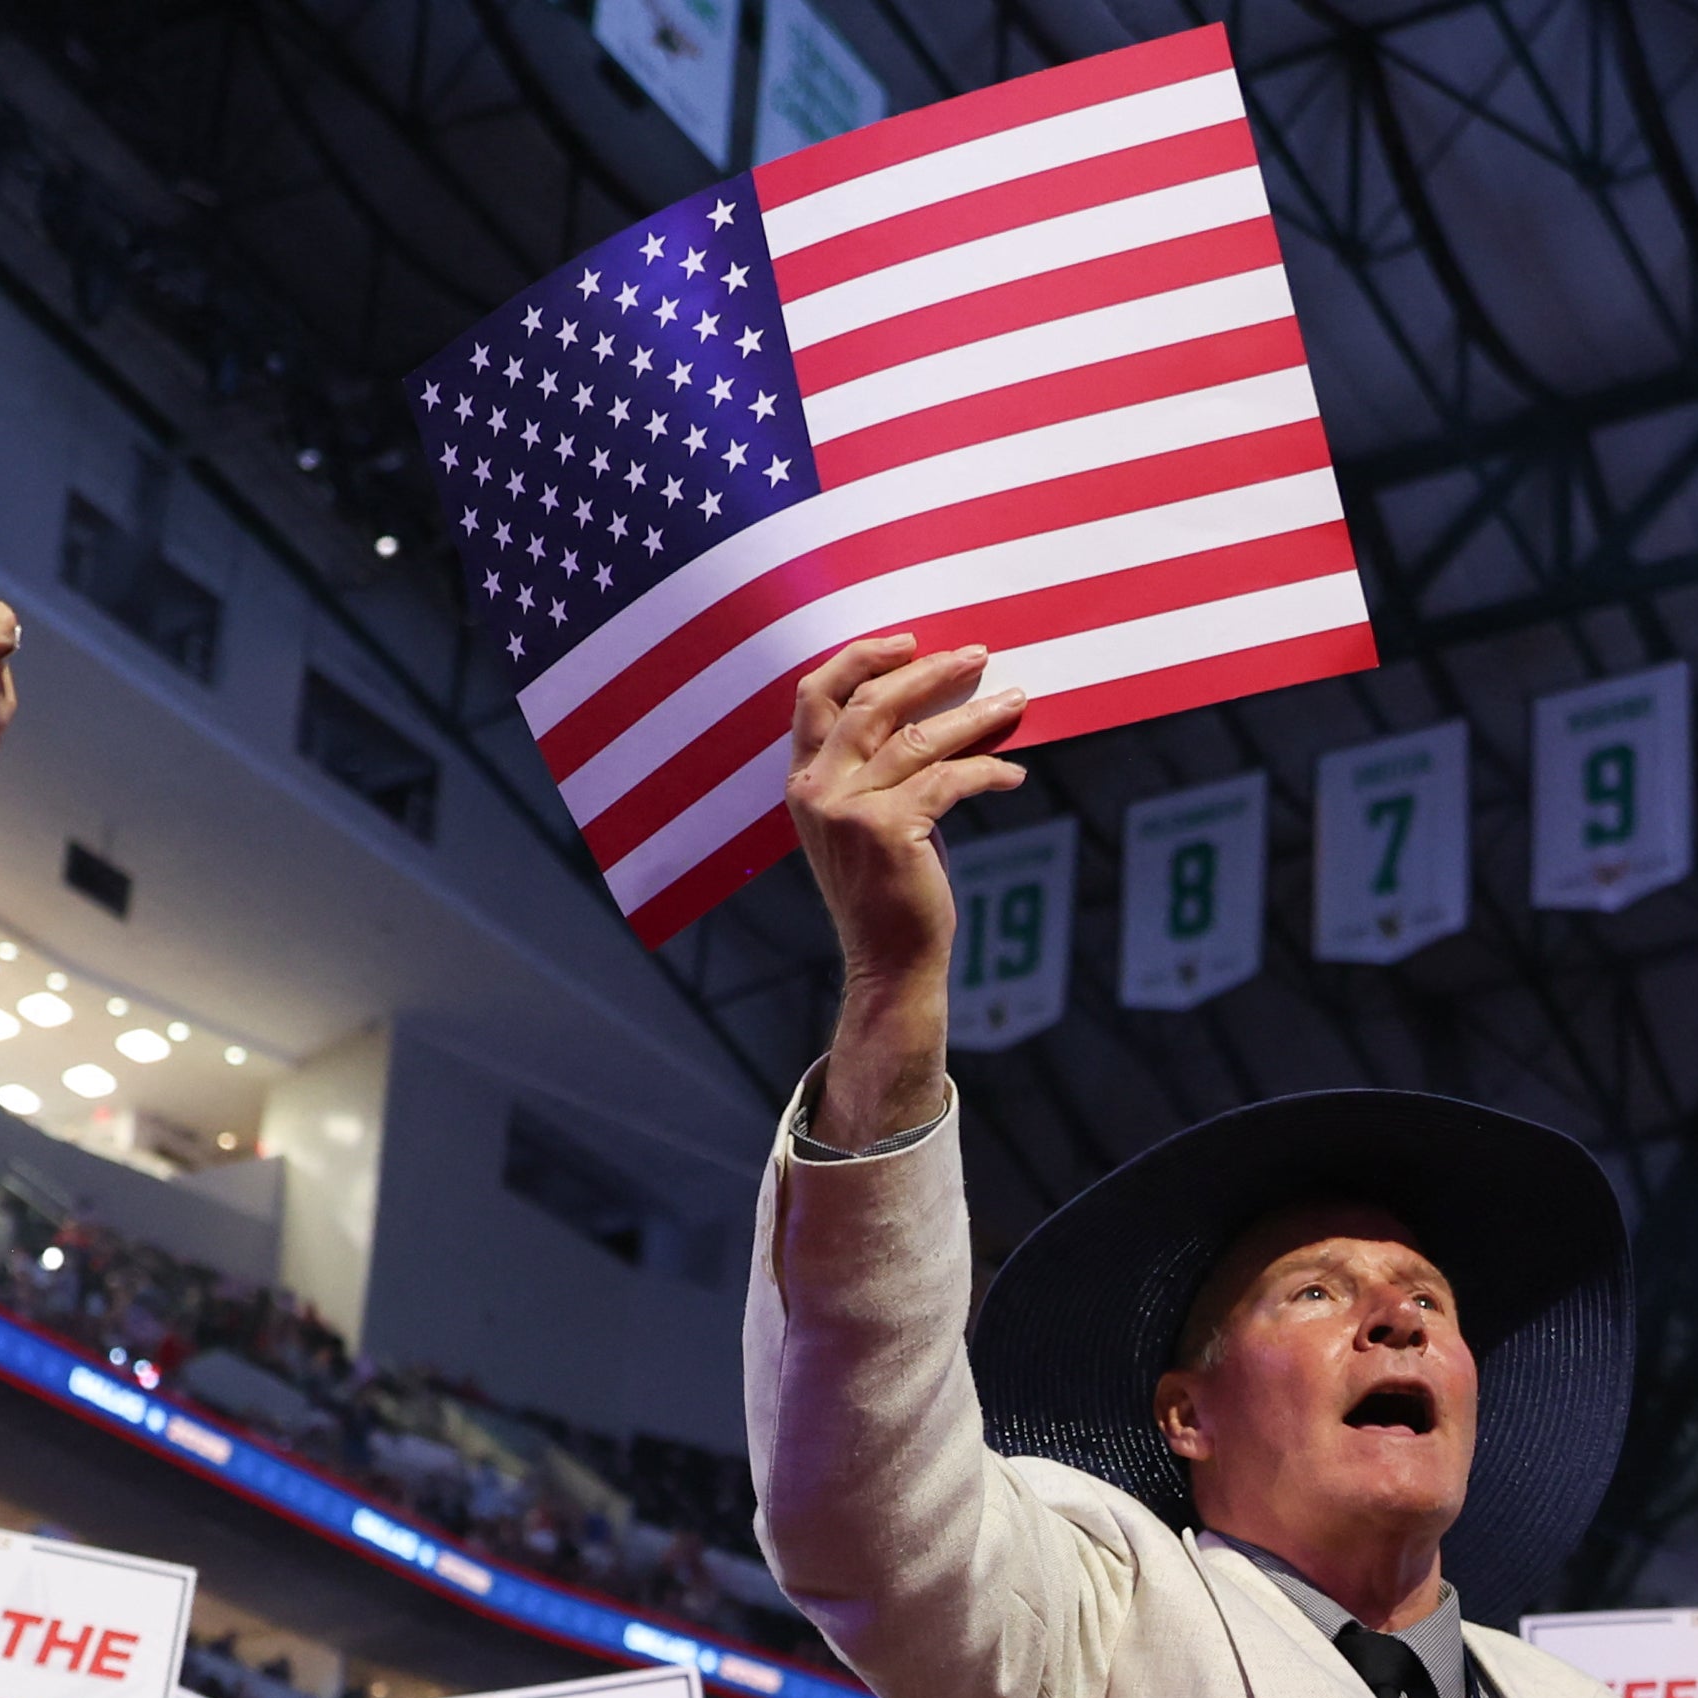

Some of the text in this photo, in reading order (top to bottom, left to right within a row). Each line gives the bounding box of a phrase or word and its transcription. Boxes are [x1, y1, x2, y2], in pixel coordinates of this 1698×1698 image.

[1367, 794, 1415, 895] 7
[1583, 744, 1636, 845] 9
[962, 883, 1044, 989] 19
[1168, 842, 1220, 941] 8
[1, 1608, 140, 1681] THE
